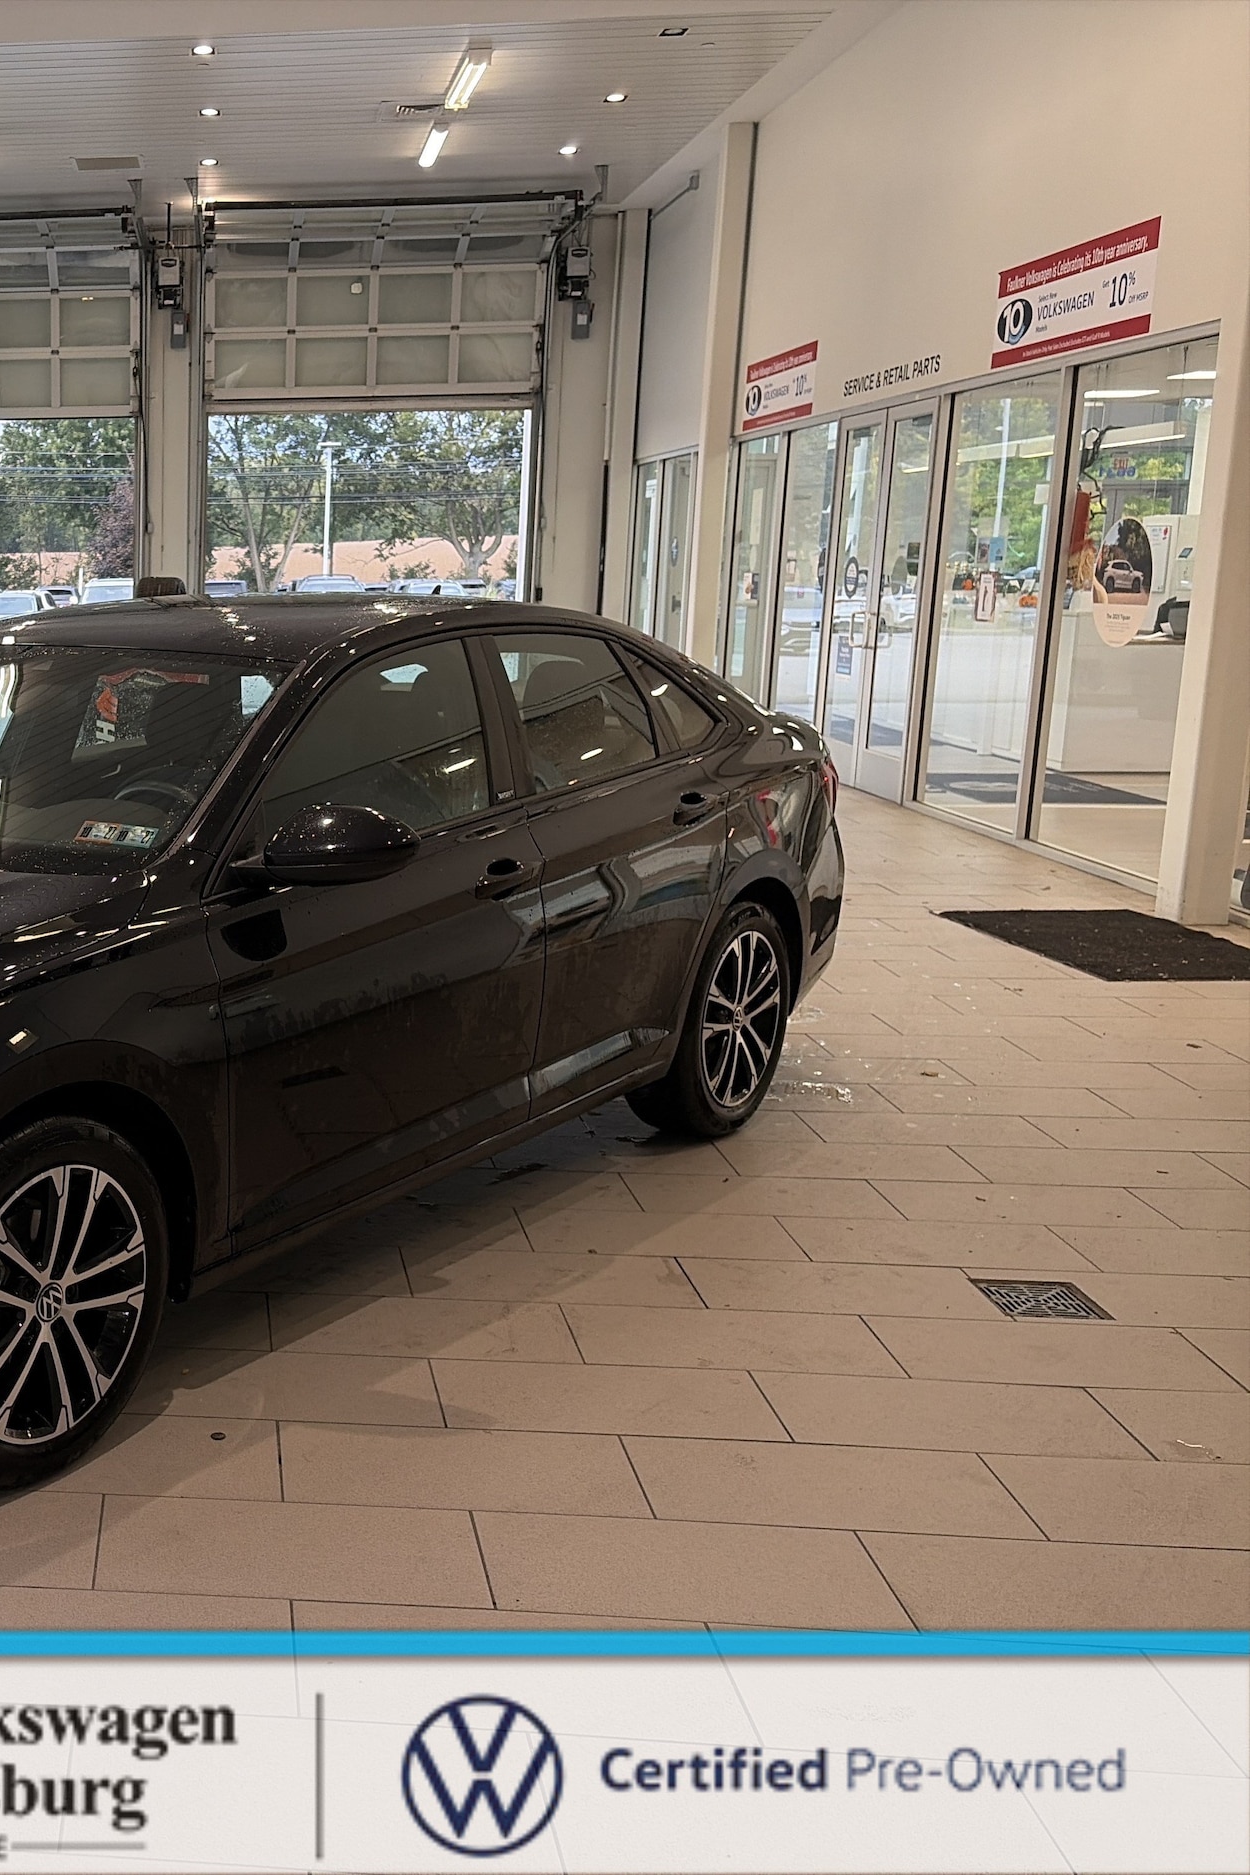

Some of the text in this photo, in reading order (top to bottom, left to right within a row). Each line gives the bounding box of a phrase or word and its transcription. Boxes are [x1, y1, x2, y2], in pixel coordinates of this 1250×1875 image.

[1007, 275, 1025, 292] Faulkner
[1025, 267, 1052, 284] Volkswagen
[1057, 253, 1084, 276] Celebrating
[1092, 246, 1104, 265] 10th
[1104, 246, 1116, 264] year
[1037, 291, 1095, 321] VOLKSWAGEN
[1136, 291, 1149, 302] MSRP
[843, 354, 941, 397] SERVICE & RETAIL PARTS
